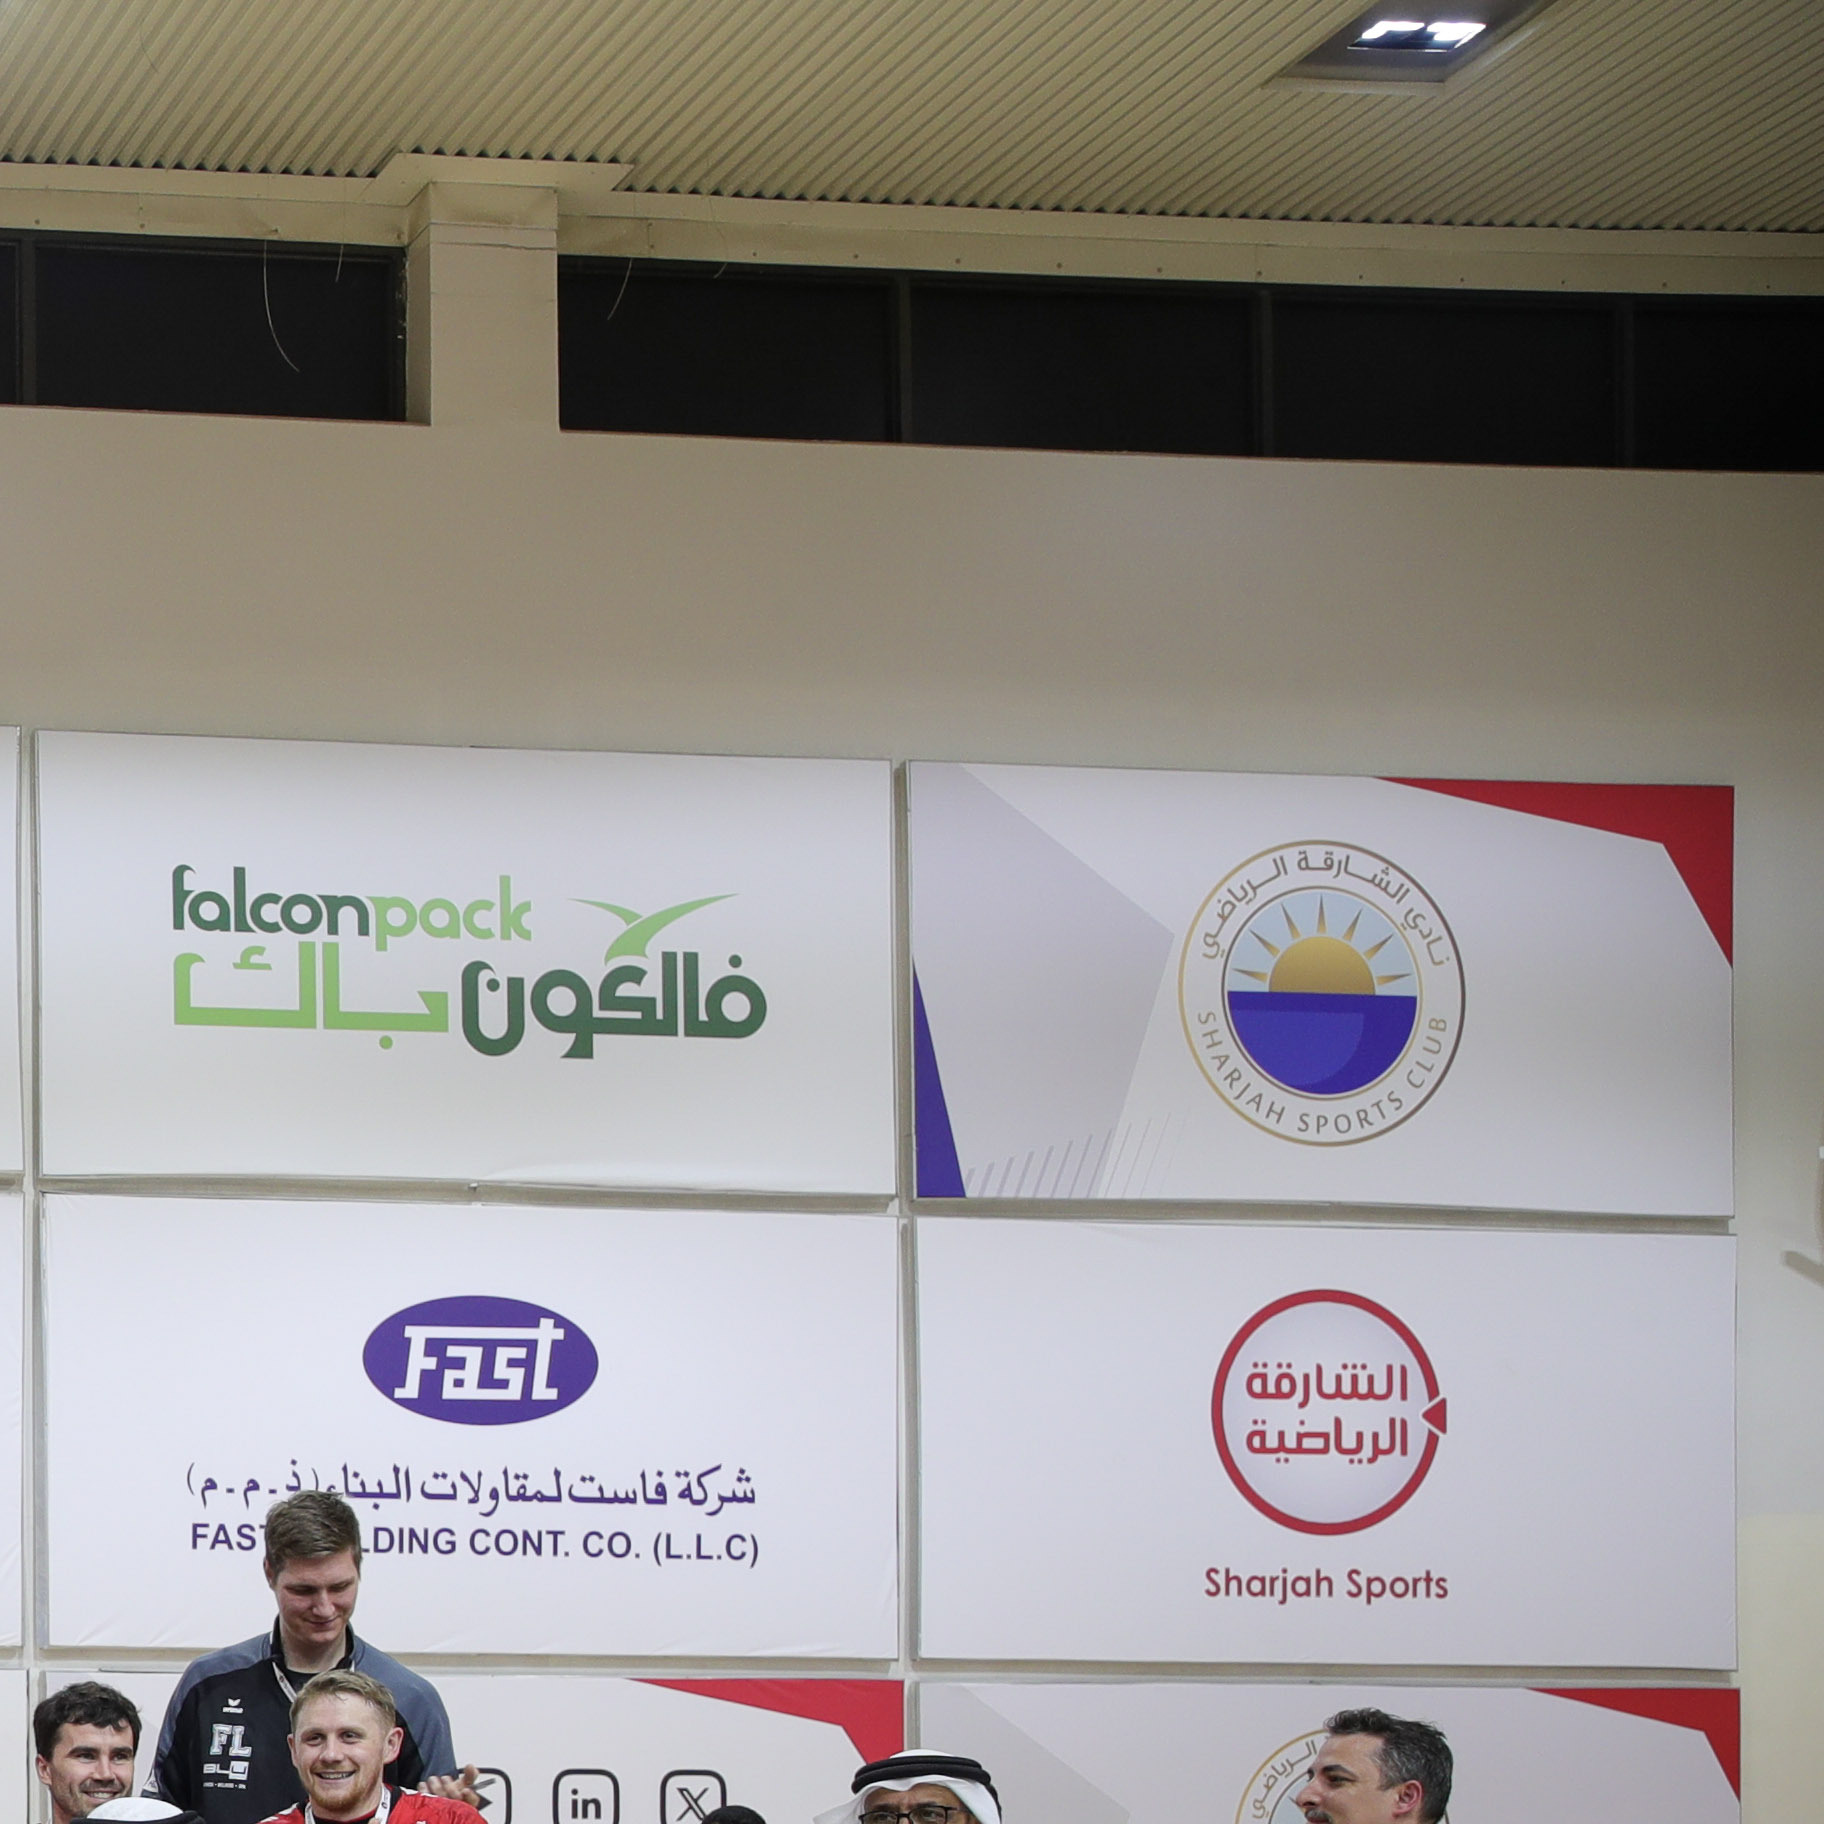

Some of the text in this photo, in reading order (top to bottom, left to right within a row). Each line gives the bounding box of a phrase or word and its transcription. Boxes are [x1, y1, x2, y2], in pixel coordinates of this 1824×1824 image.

[172, 864, 533, 952] falconpack
[1202, 850, 1450, 967] نادي الشارقة الرياضي
[1198, 1011, 1447, 1135] SHARJAH SPORTS CLUB
[1245, 1361, 1408, 1409] الشارقة
[1245, 1416, 1408, 1464] الرياضية
[420, 1466, 561, 1516] لمقاولات
[567, 1470, 667, 1505] فاست
[677, 1463, 755, 1515] شركة
[191, 1523, 760, 1567] FAS DING CONT. CO. (L.L.C)
[1205, 1567, 1449, 1605] Sharjah Sports
[209, 1723, 252, 1757] FL
